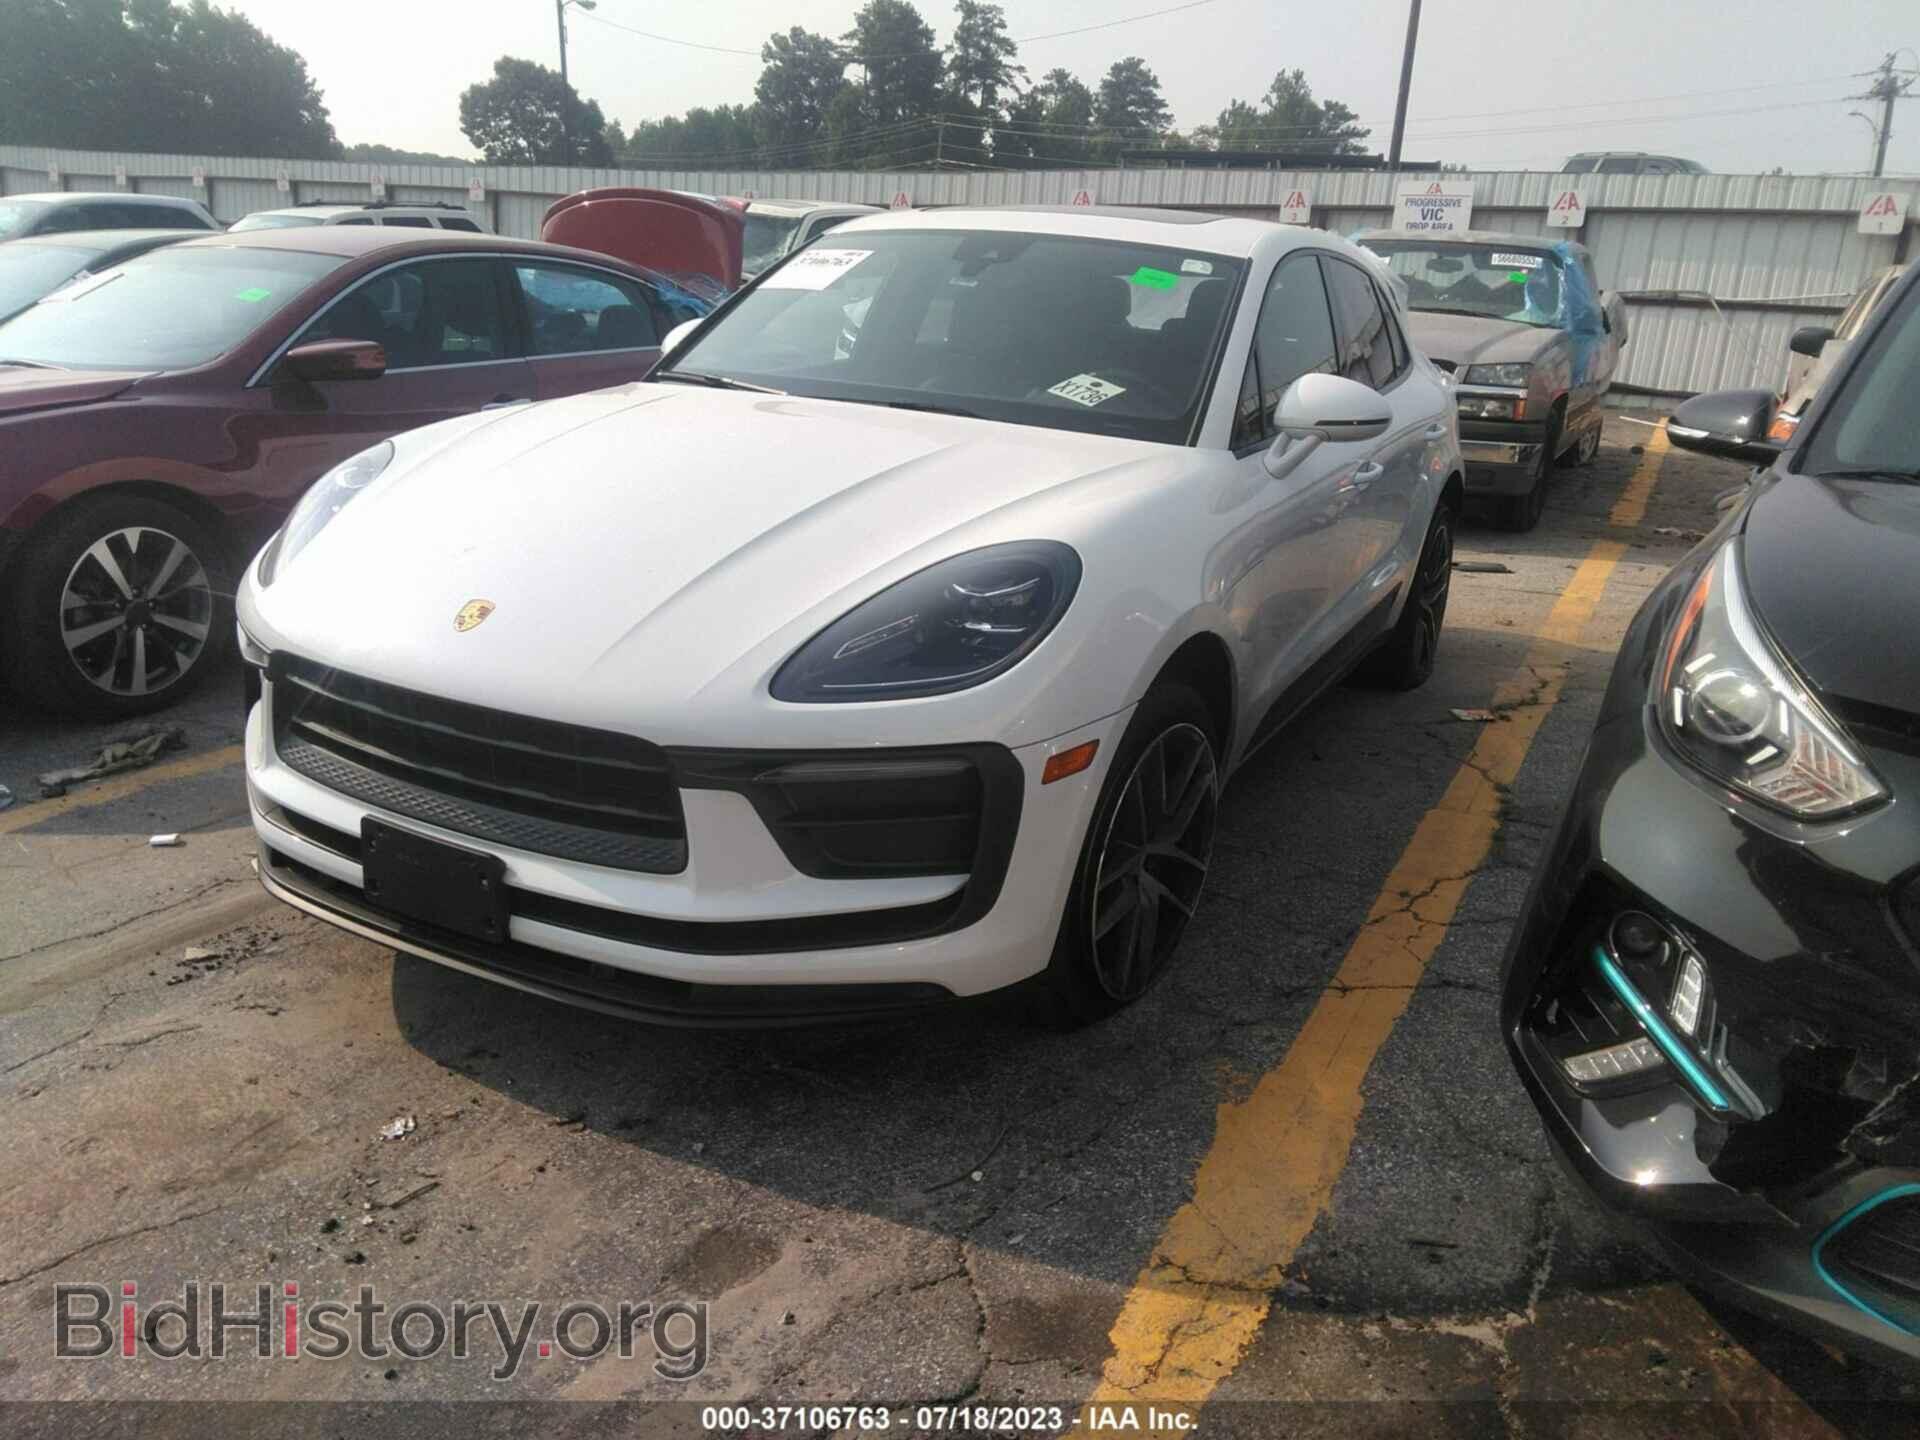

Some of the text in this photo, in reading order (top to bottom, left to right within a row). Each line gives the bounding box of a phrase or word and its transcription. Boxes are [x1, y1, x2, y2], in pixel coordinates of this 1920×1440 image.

[1405, 197, 1463, 208] PROGRESSIVE
[1421, 207, 1445, 221] VIC
[1406, 221, 1454, 231] DROP AREA
